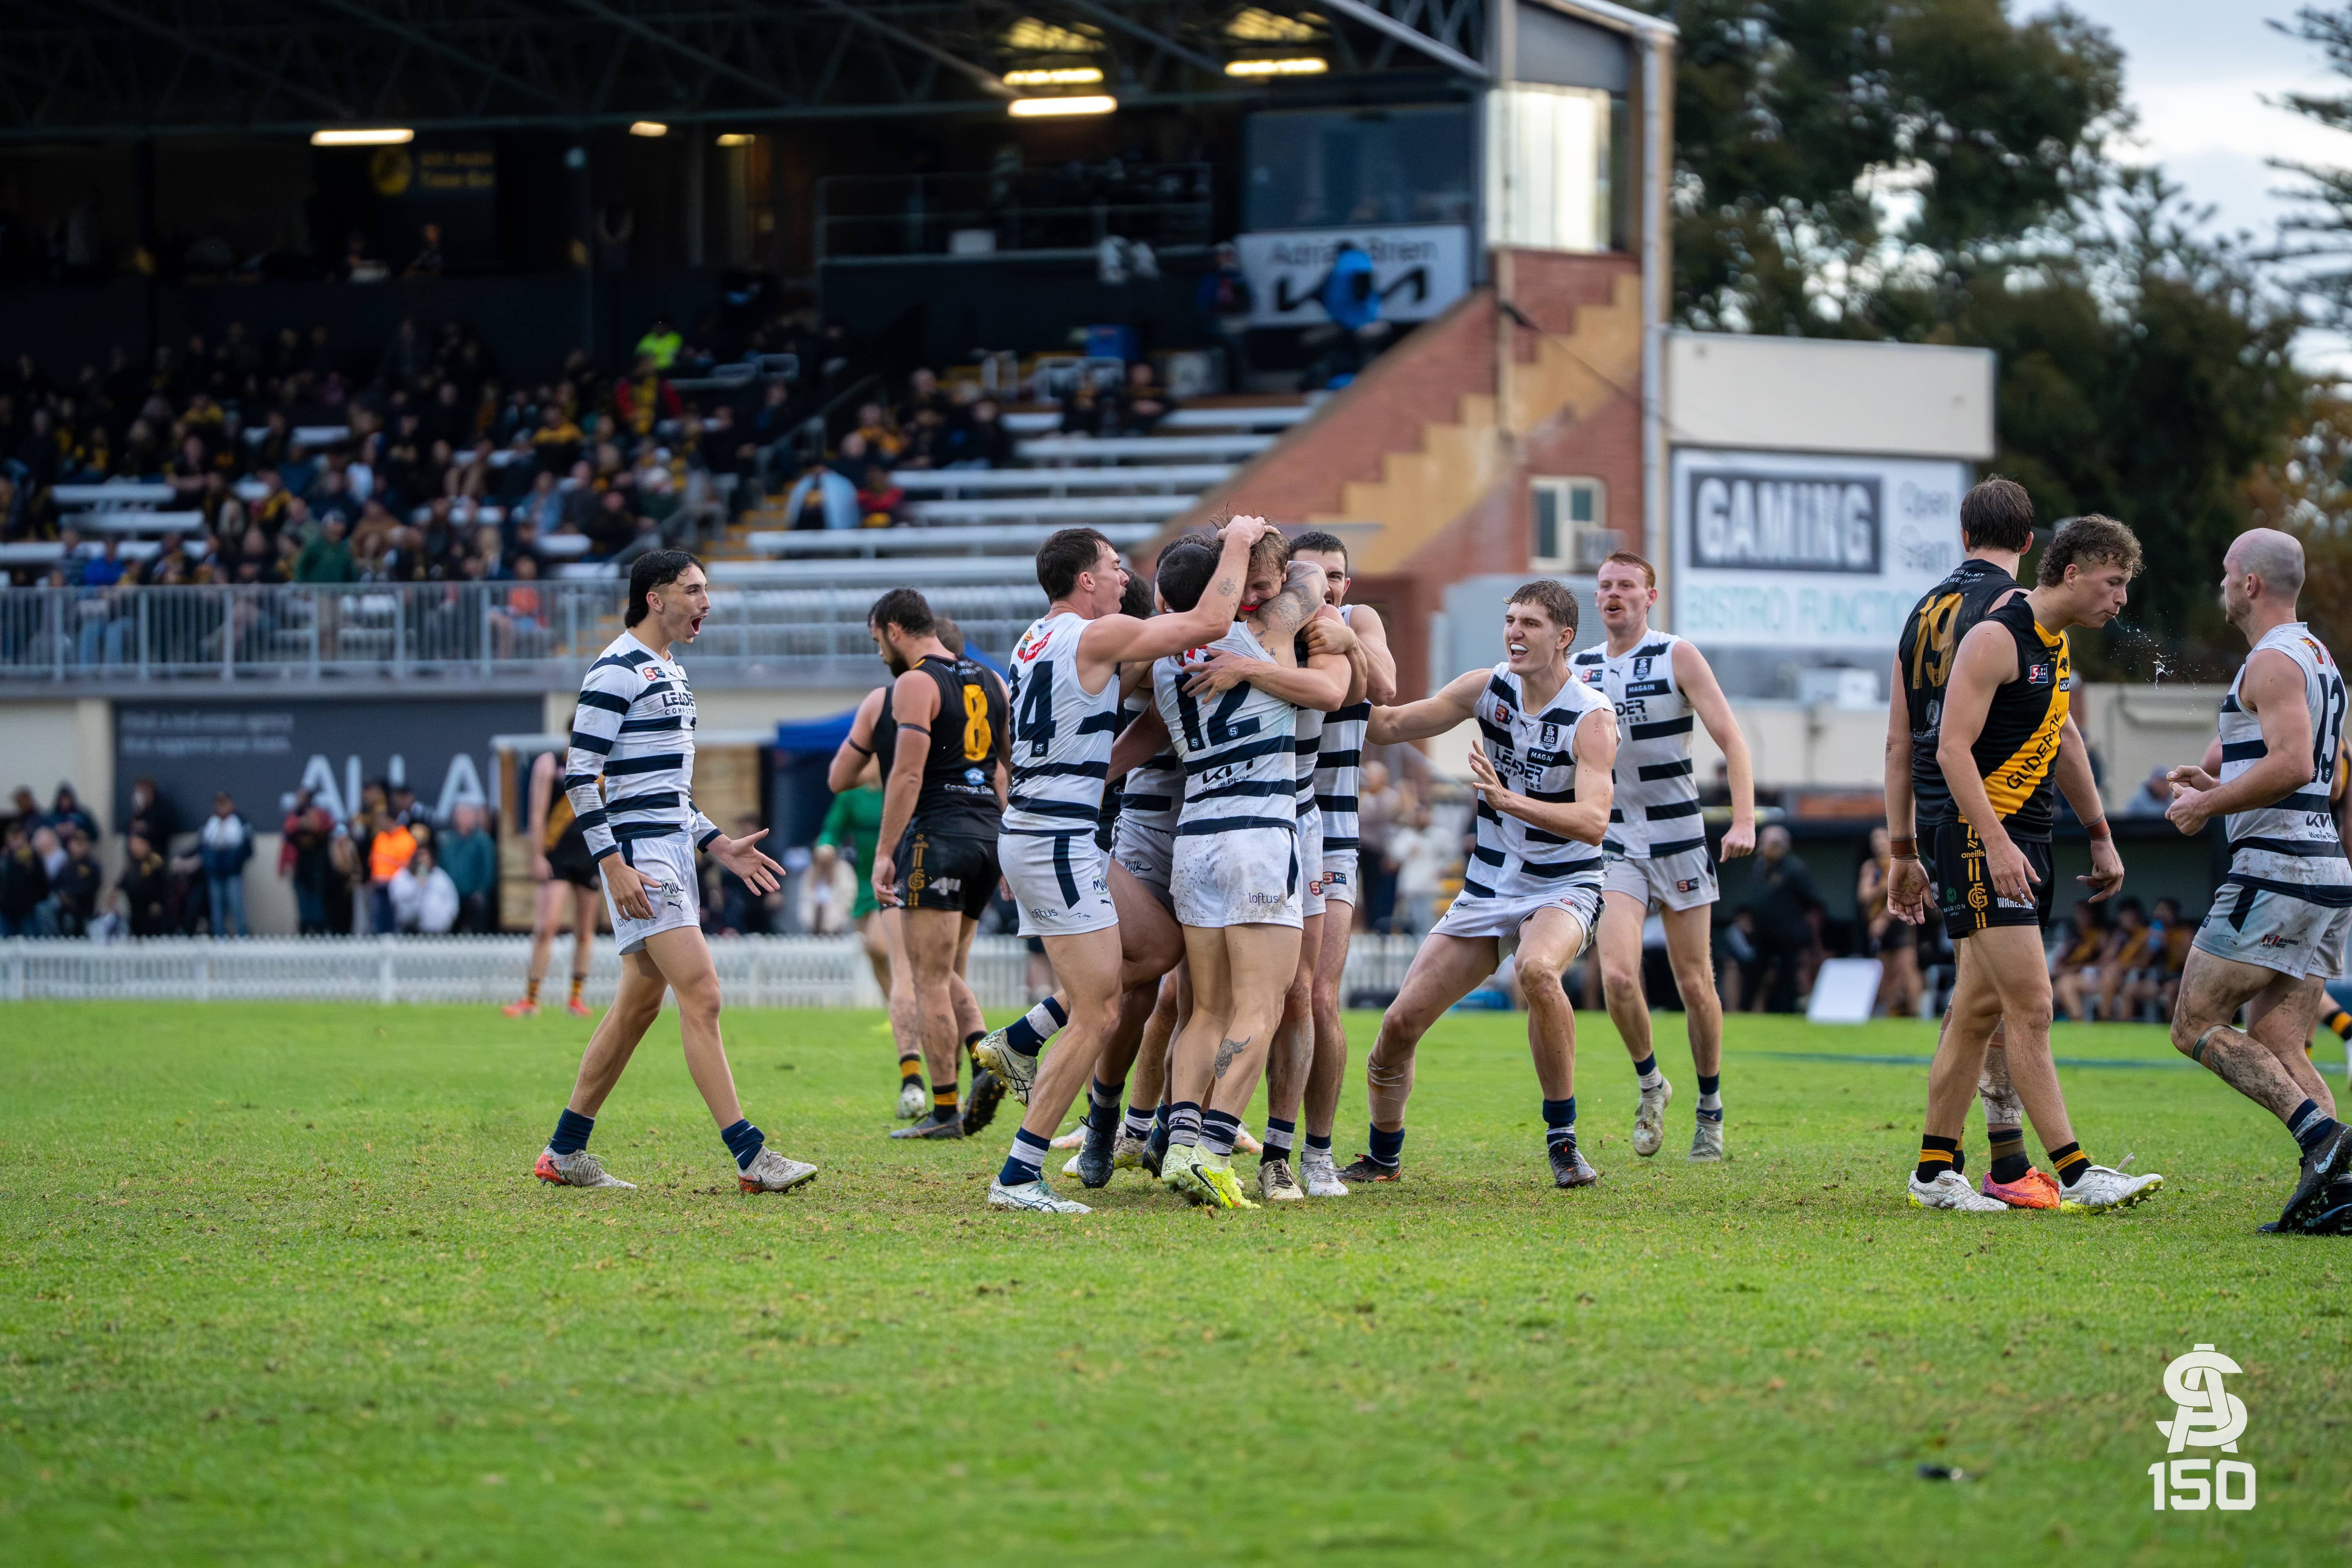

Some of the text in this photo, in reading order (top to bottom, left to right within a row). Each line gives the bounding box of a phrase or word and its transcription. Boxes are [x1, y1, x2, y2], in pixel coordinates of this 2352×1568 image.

[1697, 477, 1873, 566] GAMING
[1797, 588, 1923, 634] FUNCTIO
[1913, 593, 1963, 689] 19
[1628, 684, 1655, 693] MAGAIN
[661, 692, 695, 707] LEADE
[1174, 662, 1261, 752] 12
[1615, 699, 1646, 716] DER
[963, 684, 992, 761] 8
[2311, 673, 2345, 784] 13
[1494, 761, 1541, 790] COMPTERS
[1961, 849, 1985, 858] oneills
[661, 882, 684, 894] Milk
[1249, 892, 1278, 906] loftus
[1029, 909, 1058, 921] loftus
[1944, 904, 1966, 913] MARION
